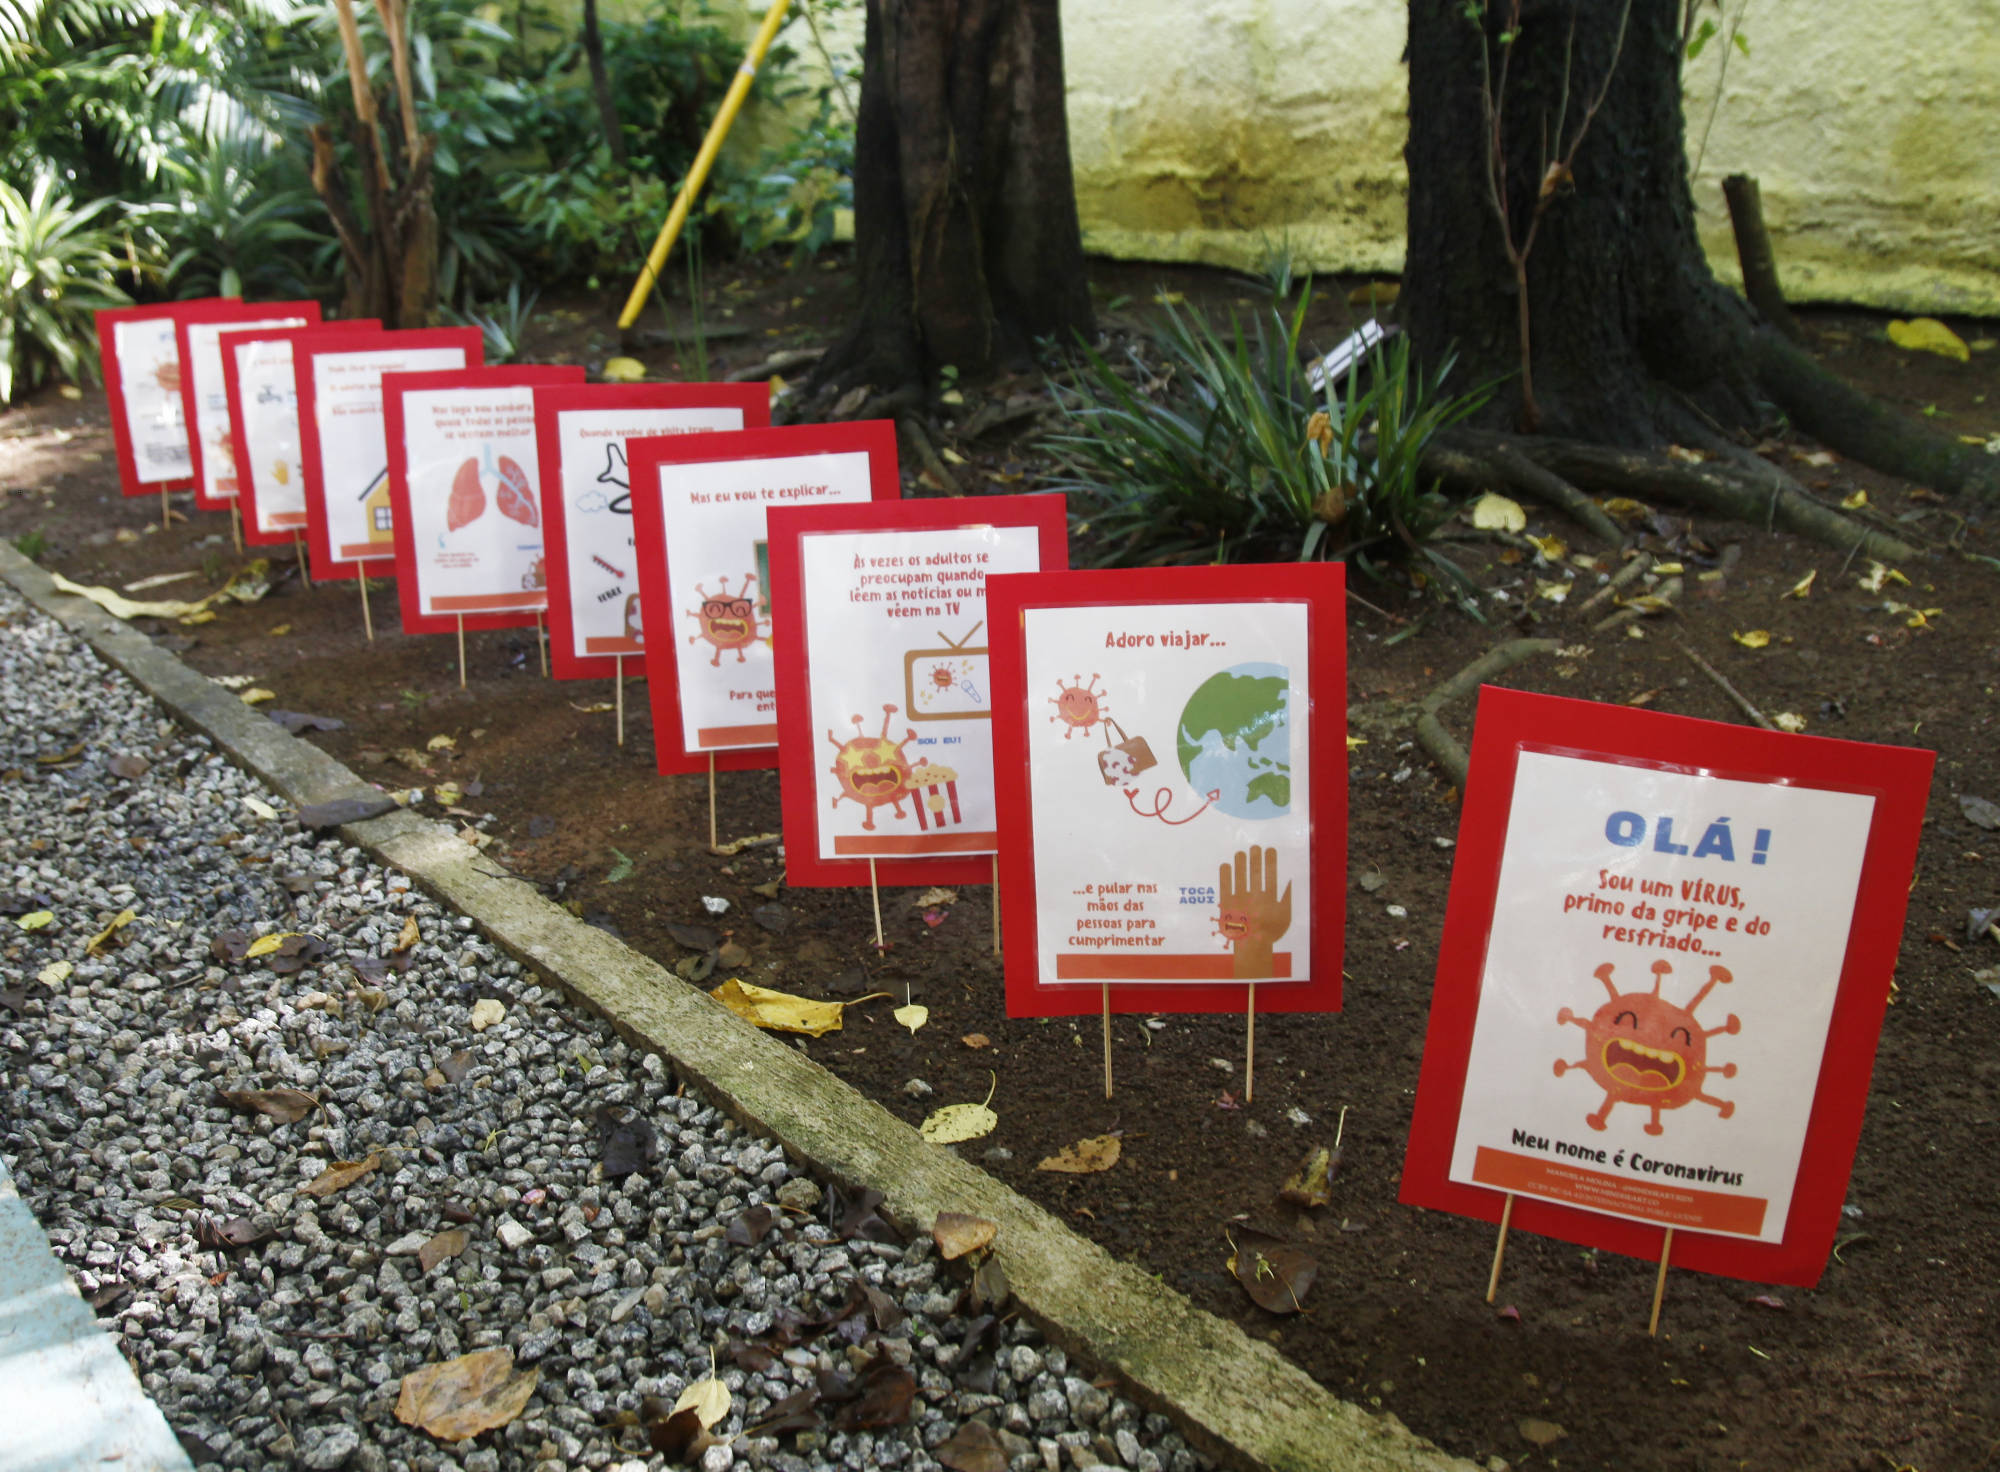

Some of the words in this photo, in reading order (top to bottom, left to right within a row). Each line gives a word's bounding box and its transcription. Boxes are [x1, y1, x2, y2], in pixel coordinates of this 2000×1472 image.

[715, 492, 731, 502] eu
[734, 490, 757, 502] vou
[761, 488, 775, 499] te
[779, 484, 841, 501] explicar...
[870, 556, 904, 568] vezes
[908, 555, 920, 566] os
[925, 552, 972, 566] adultos
[977, 552, 989, 563] se
[860, 572, 933, 588] preocupam
[937, 568, 985, 586] quando
[886, 590, 897, 601] as
[956, 587, 972, 598] ou
[926, 605, 941, 617] na
[945, 601, 960, 616] TV
[1105, 631, 1155, 648] Adoro
[1160, 629, 1226, 650] viajar...
[757, 702, 776, 712] ent
[917, 737, 937, 745] SOU
[1605, 810, 1772, 865] OLÁ!
[1098, 882, 1133, 897] pular
[1137, 883, 1158, 894] nas
[1179, 886, 1215, 895] TOCA
[1598, 869, 1634, 892] Sou
[1641, 879, 1673, 898] um
[1681, 878, 1745, 911] VÍRUS,
[1087, 898, 1119, 912] mãos
[1123, 899, 1144, 912] das
[1179, 896, 1215, 905] AQUI
[1563, 892, 1625, 914] primo
[1631, 901, 1656, 921] da
[1662, 908, 1718, 932] gripe
[1725, 917, 1738, 932] e
[1745, 915, 1771, 936] do
[1076, 918, 1122, 932] pessoas
[1126, 918, 1156, 932] para
[1068, 934, 1166, 949] cumprimentar
[1602, 923, 1721, 957] resfriado...
[1512, 1128, 1549, 1151] Meu
[1556, 1141, 1606, 1164] nome
[1613, 1149, 1625, 1168] é
[1630, 1153, 1744, 1187] Coronavirus
